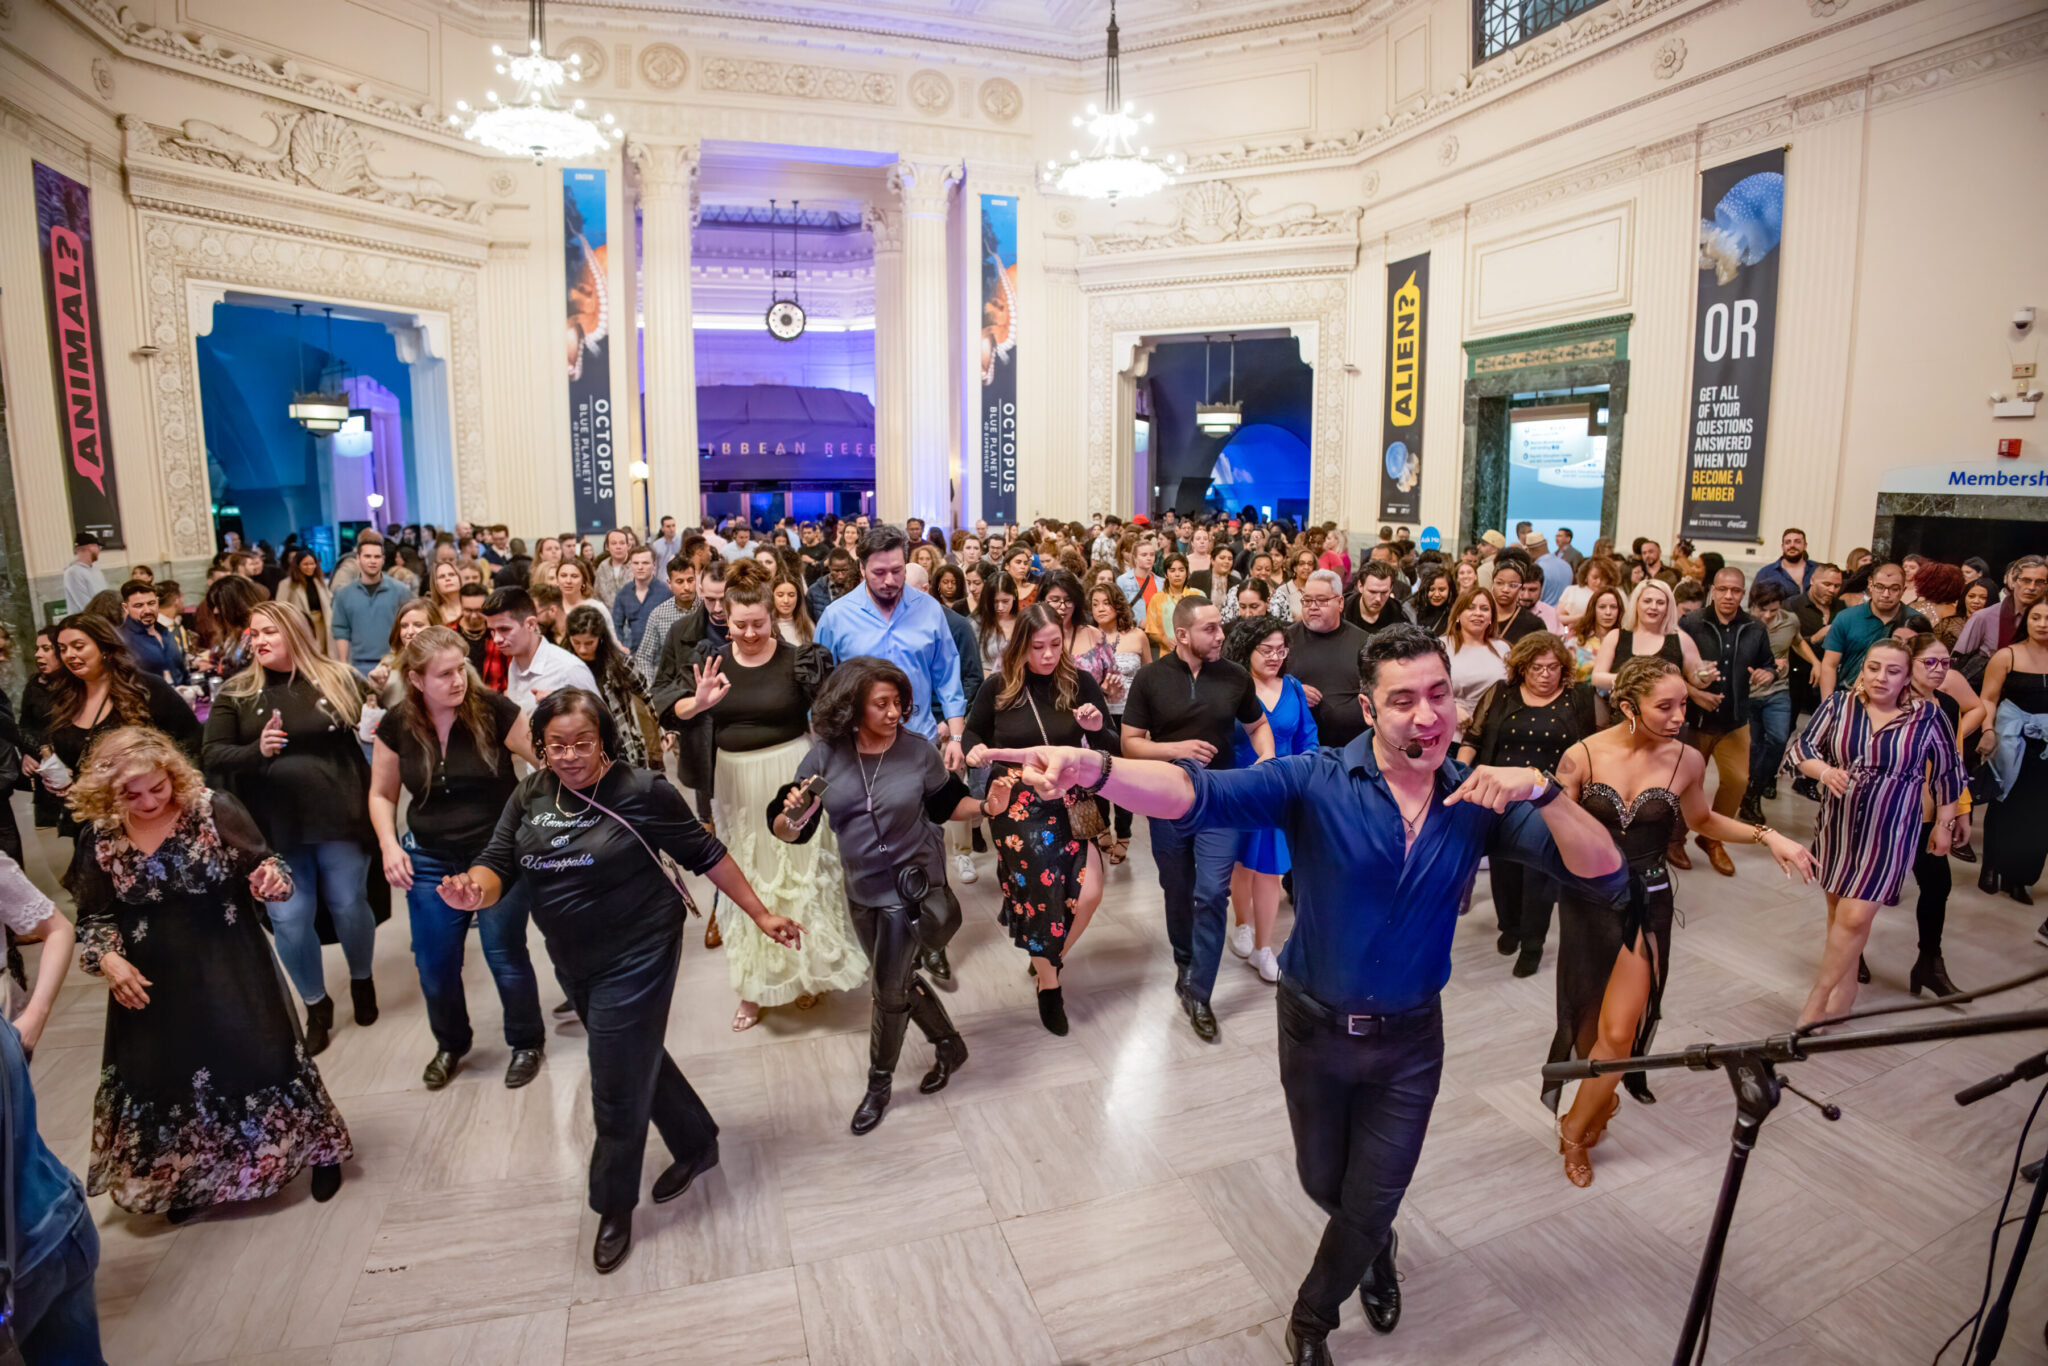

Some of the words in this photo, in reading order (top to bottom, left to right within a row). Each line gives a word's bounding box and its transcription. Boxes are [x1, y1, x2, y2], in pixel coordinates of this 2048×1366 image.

[1703, 299, 1758, 362] OR
[56, 235, 100, 468] ANIMAL?
[1395, 294, 1416, 417] ALIEN?
[1699, 386, 1718, 402] GET
[1720, 385, 1739, 400] ALL
[579, 403, 589, 433] BLUE
[989, 406, 998, 433] BLUE
[1698, 403, 1710, 418] OF
[1712, 401, 1741, 418] YOUR
[1696, 418, 1753, 436] QUESTIONS
[573, 432, 581, 478] EXPERIENCE
[595, 398, 613, 500] OCTOPUS
[989, 437, 998, 478] PLANET
[1002, 402, 1016, 493] OCTOPUS
[1694, 435, 1752, 452] ANSWERED
[580, 438, 592, 483] PLANET
[1693, 452, 1724, 468] WHEN
[1726, 452, 1748, 468] YOU
[1692, 469, 1734, 485] BECOME
[1735, 469, 1743, 485] A
[1691, 486, 1735, 502] MEMBER
[531, 811, 602, 828] Remarkabl
